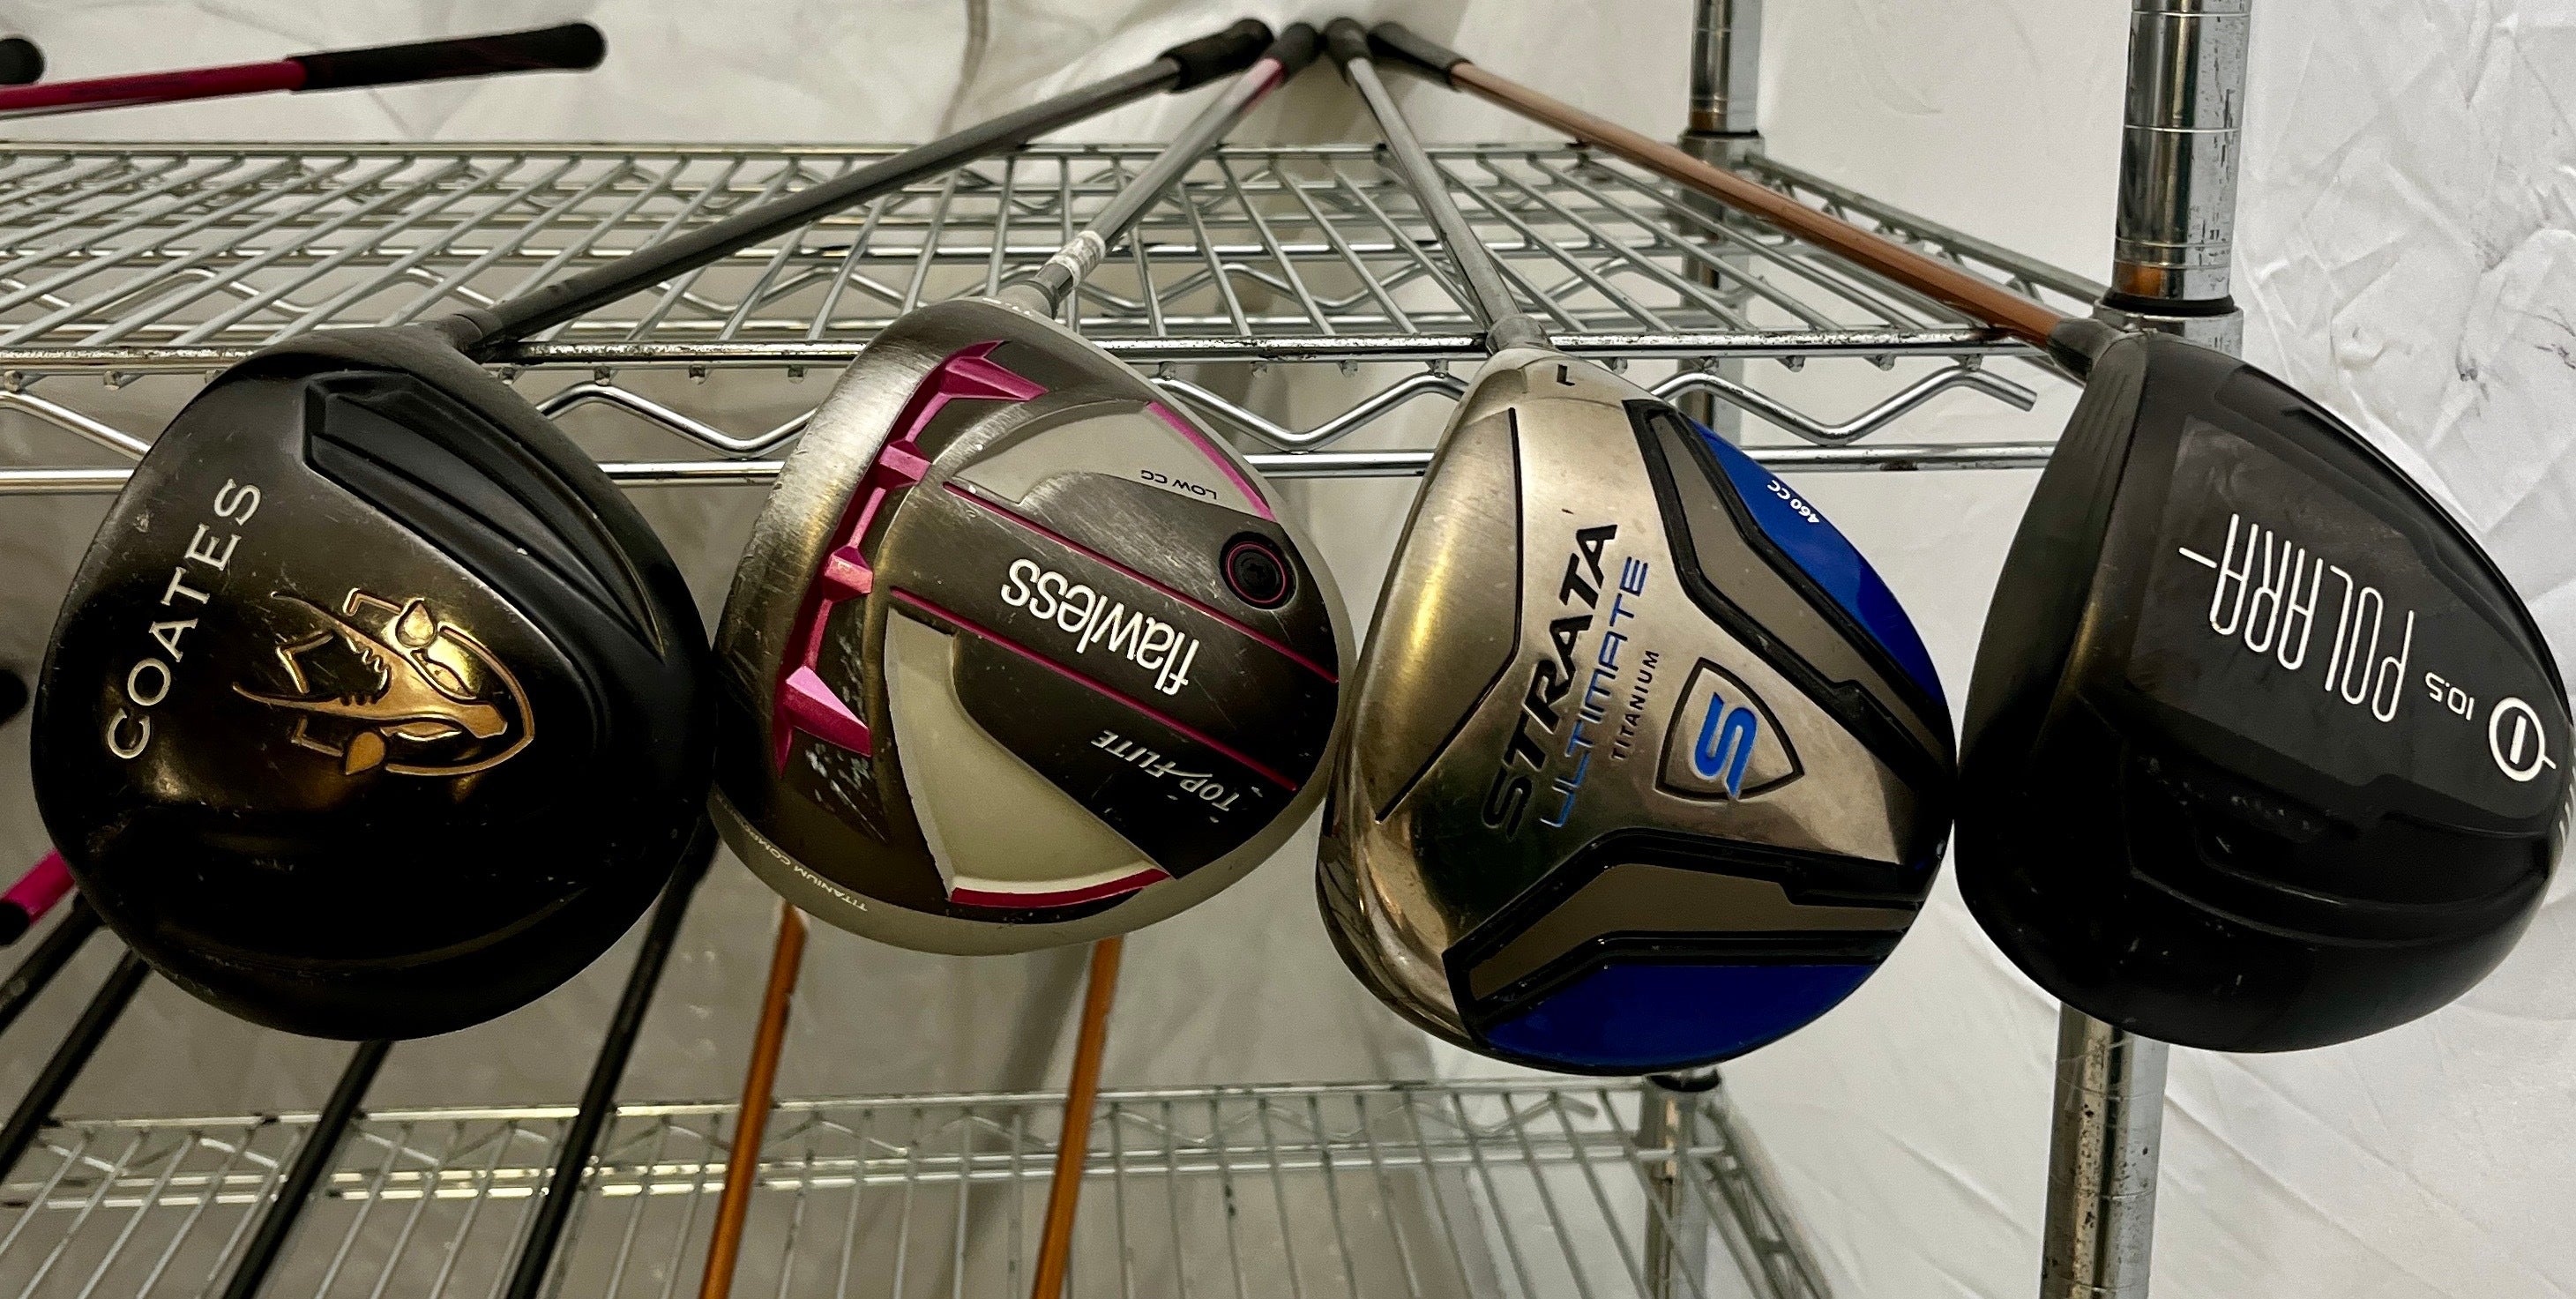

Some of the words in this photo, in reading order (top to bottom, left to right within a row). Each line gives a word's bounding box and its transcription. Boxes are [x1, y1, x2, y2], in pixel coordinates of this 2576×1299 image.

[1140, 469, 1168, 484] CC
[1172, 479, 1217, 500] LOW
[1766, 479, 1791, 500] CC
[1789, 498, 1820, 523] 460
[107, 478, 262, 759] COATES
[1000, 558, 1200, 696] flawless
[2207, 513, 2415, 723] POLARA
[1482, 524, 1618, 840] STRATA
[1540, 556, 1648, 828] ULTIMATE
[1611, 650, 1660, 761] TITANIUM
[2425, 671, 2475, 721] 10.5
[1694, 691, 1758, 798] S
[794, 865, 868, 912] TITANIUM
